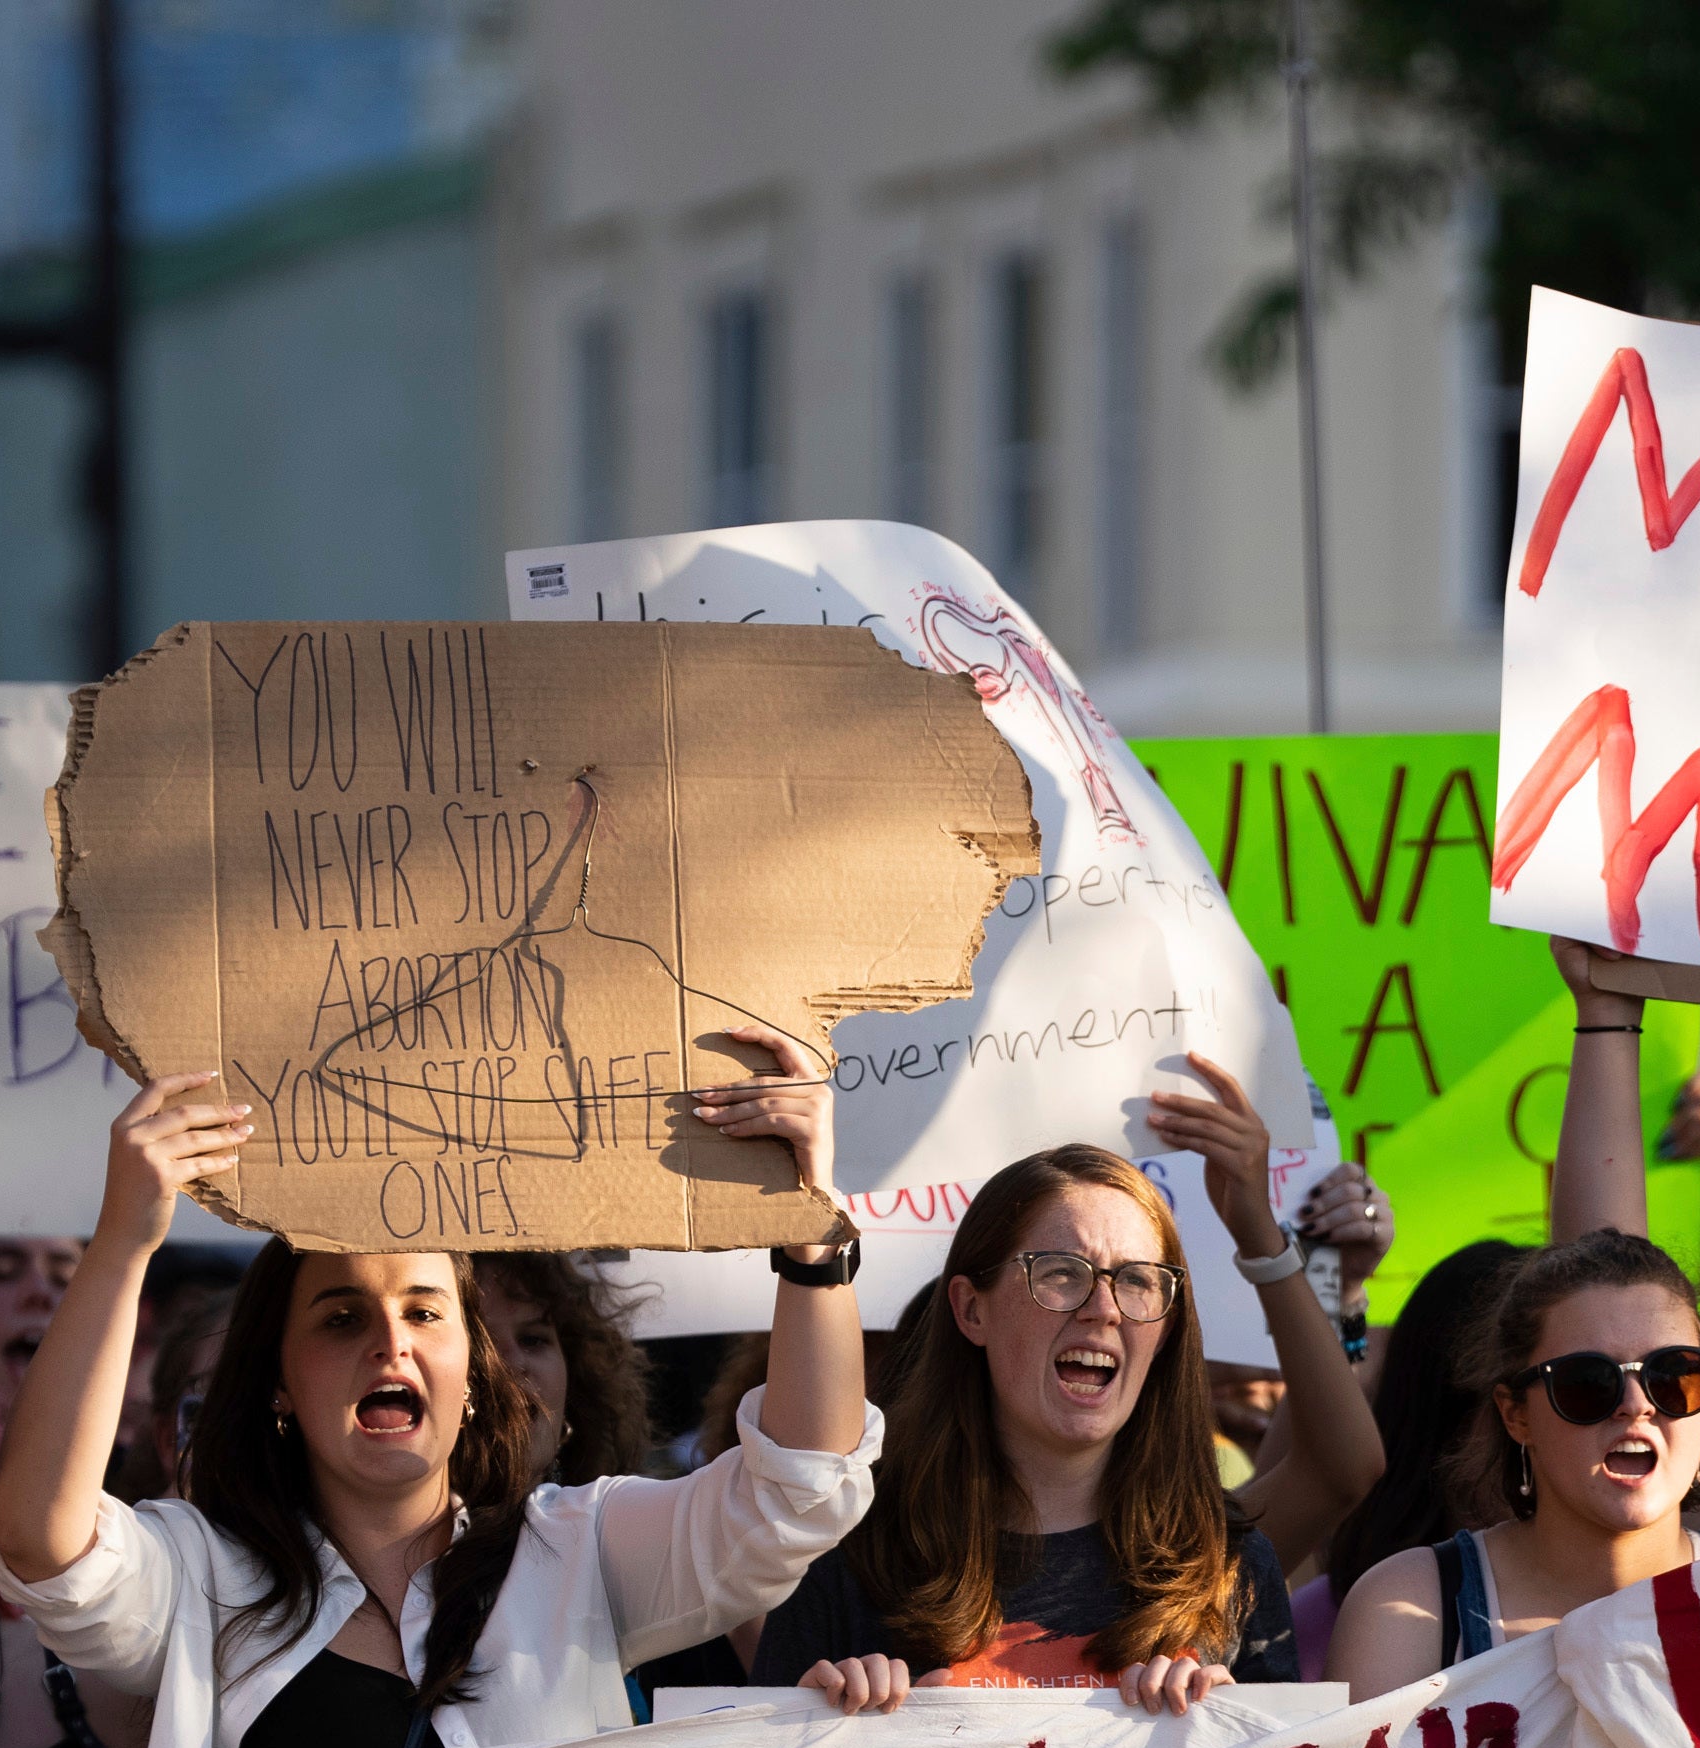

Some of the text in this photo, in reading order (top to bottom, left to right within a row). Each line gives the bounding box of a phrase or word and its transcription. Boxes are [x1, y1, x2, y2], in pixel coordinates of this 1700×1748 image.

[215, 626, 503, 798] YOU WILL
[265, 801, 551, 931] NEVER STOP
[309, 939, 564, 1054] ABORTION.
[833, 982, 1220, 1092] overnment!!
[231, 1051, 671, 1168] YOU'LL STOP SAFE
[379, 1154, 529, 1240] ONES.
